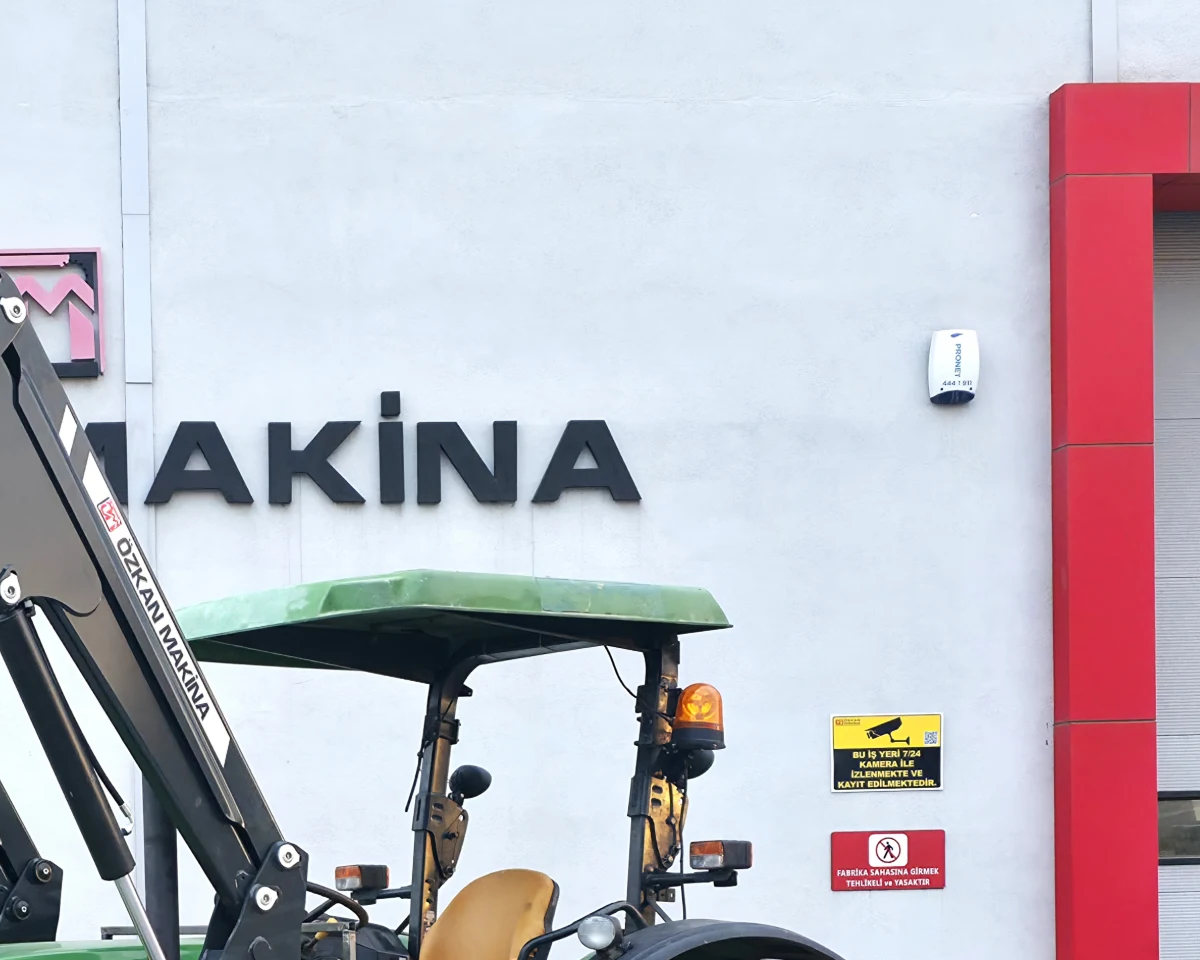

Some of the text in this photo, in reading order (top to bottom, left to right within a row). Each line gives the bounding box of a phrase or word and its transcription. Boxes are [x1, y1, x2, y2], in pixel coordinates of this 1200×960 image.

[116, 537, 211, 722] ÖZKAN MAKİNA
[852, 751, 865, 760] BU
[868, 750, 877, 760] İŞ
[879, 749, 901, 758] YERİ
[859, 760, 915, 768] KAMERA İLE
[851, 769, 923, 779] İZLENMEKTE VE
[837, 778, 937, 789] KAYIT EDİLMEKTEDİR.
[837, 866, 940, 877] FABRİKA SAHASINA GİRMEK
[846, 878, 883, 887] TEHLİKELİ
[894, 878, 930, 886] YASAKTIR
